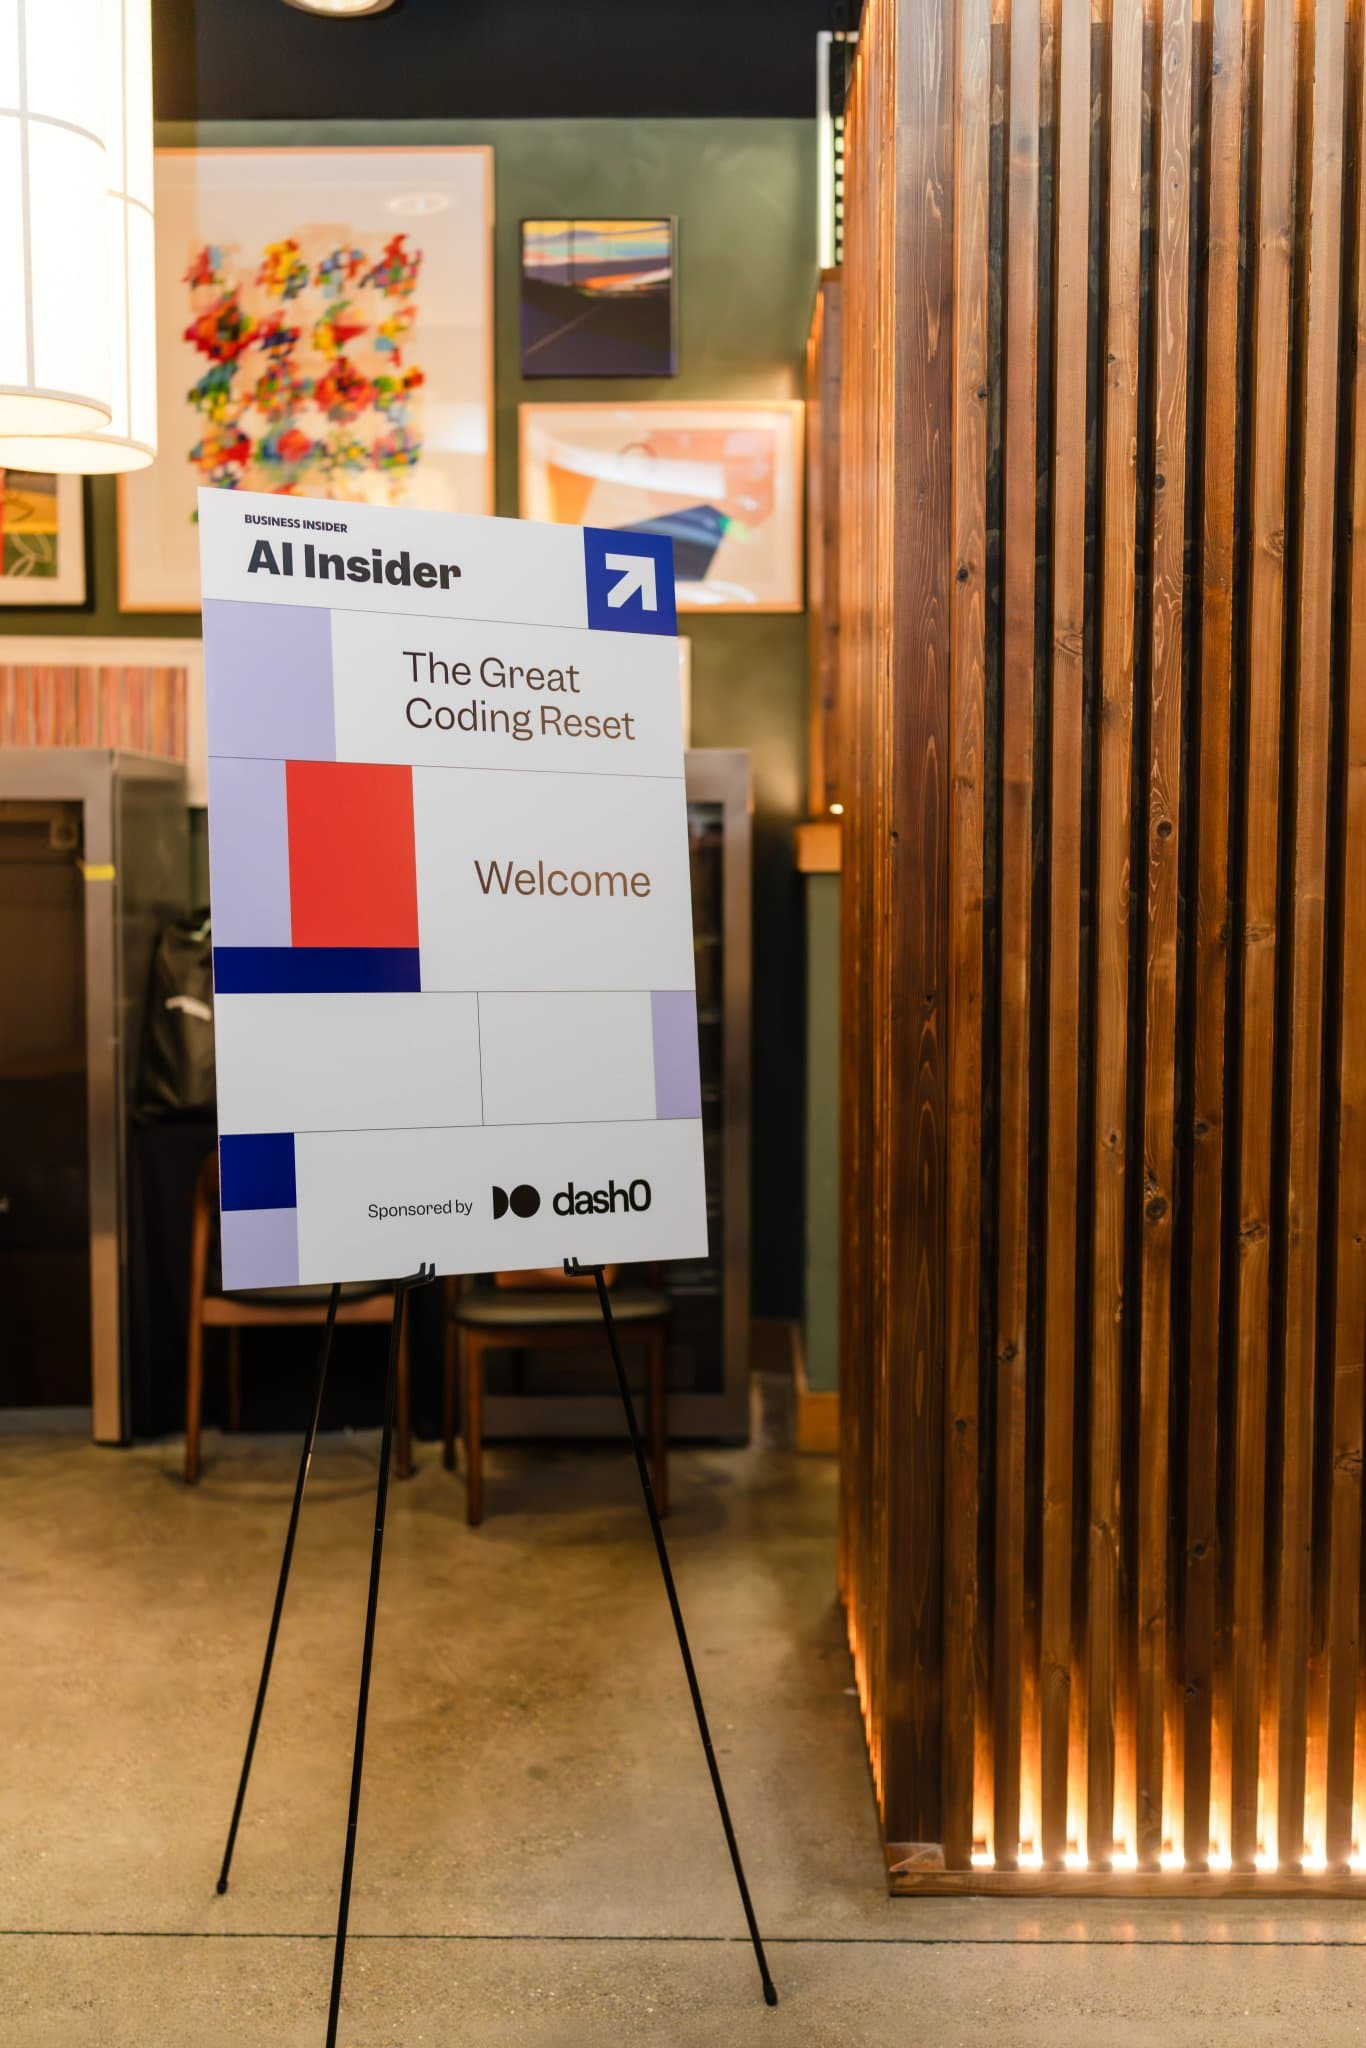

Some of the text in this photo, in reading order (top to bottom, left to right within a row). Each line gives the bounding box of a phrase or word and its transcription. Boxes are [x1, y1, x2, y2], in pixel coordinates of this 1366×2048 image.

[245, 514, 347, 533] BUSINESS INSIDER
[248, 540, 461, 590] AI Insider
[403, 651, 580, 693] The Great
[406, 697, 635, 741] Coding Reset
[474, 860, 650, 897] Welcome
[368, 1200, 472, 1220] Sponsored by
